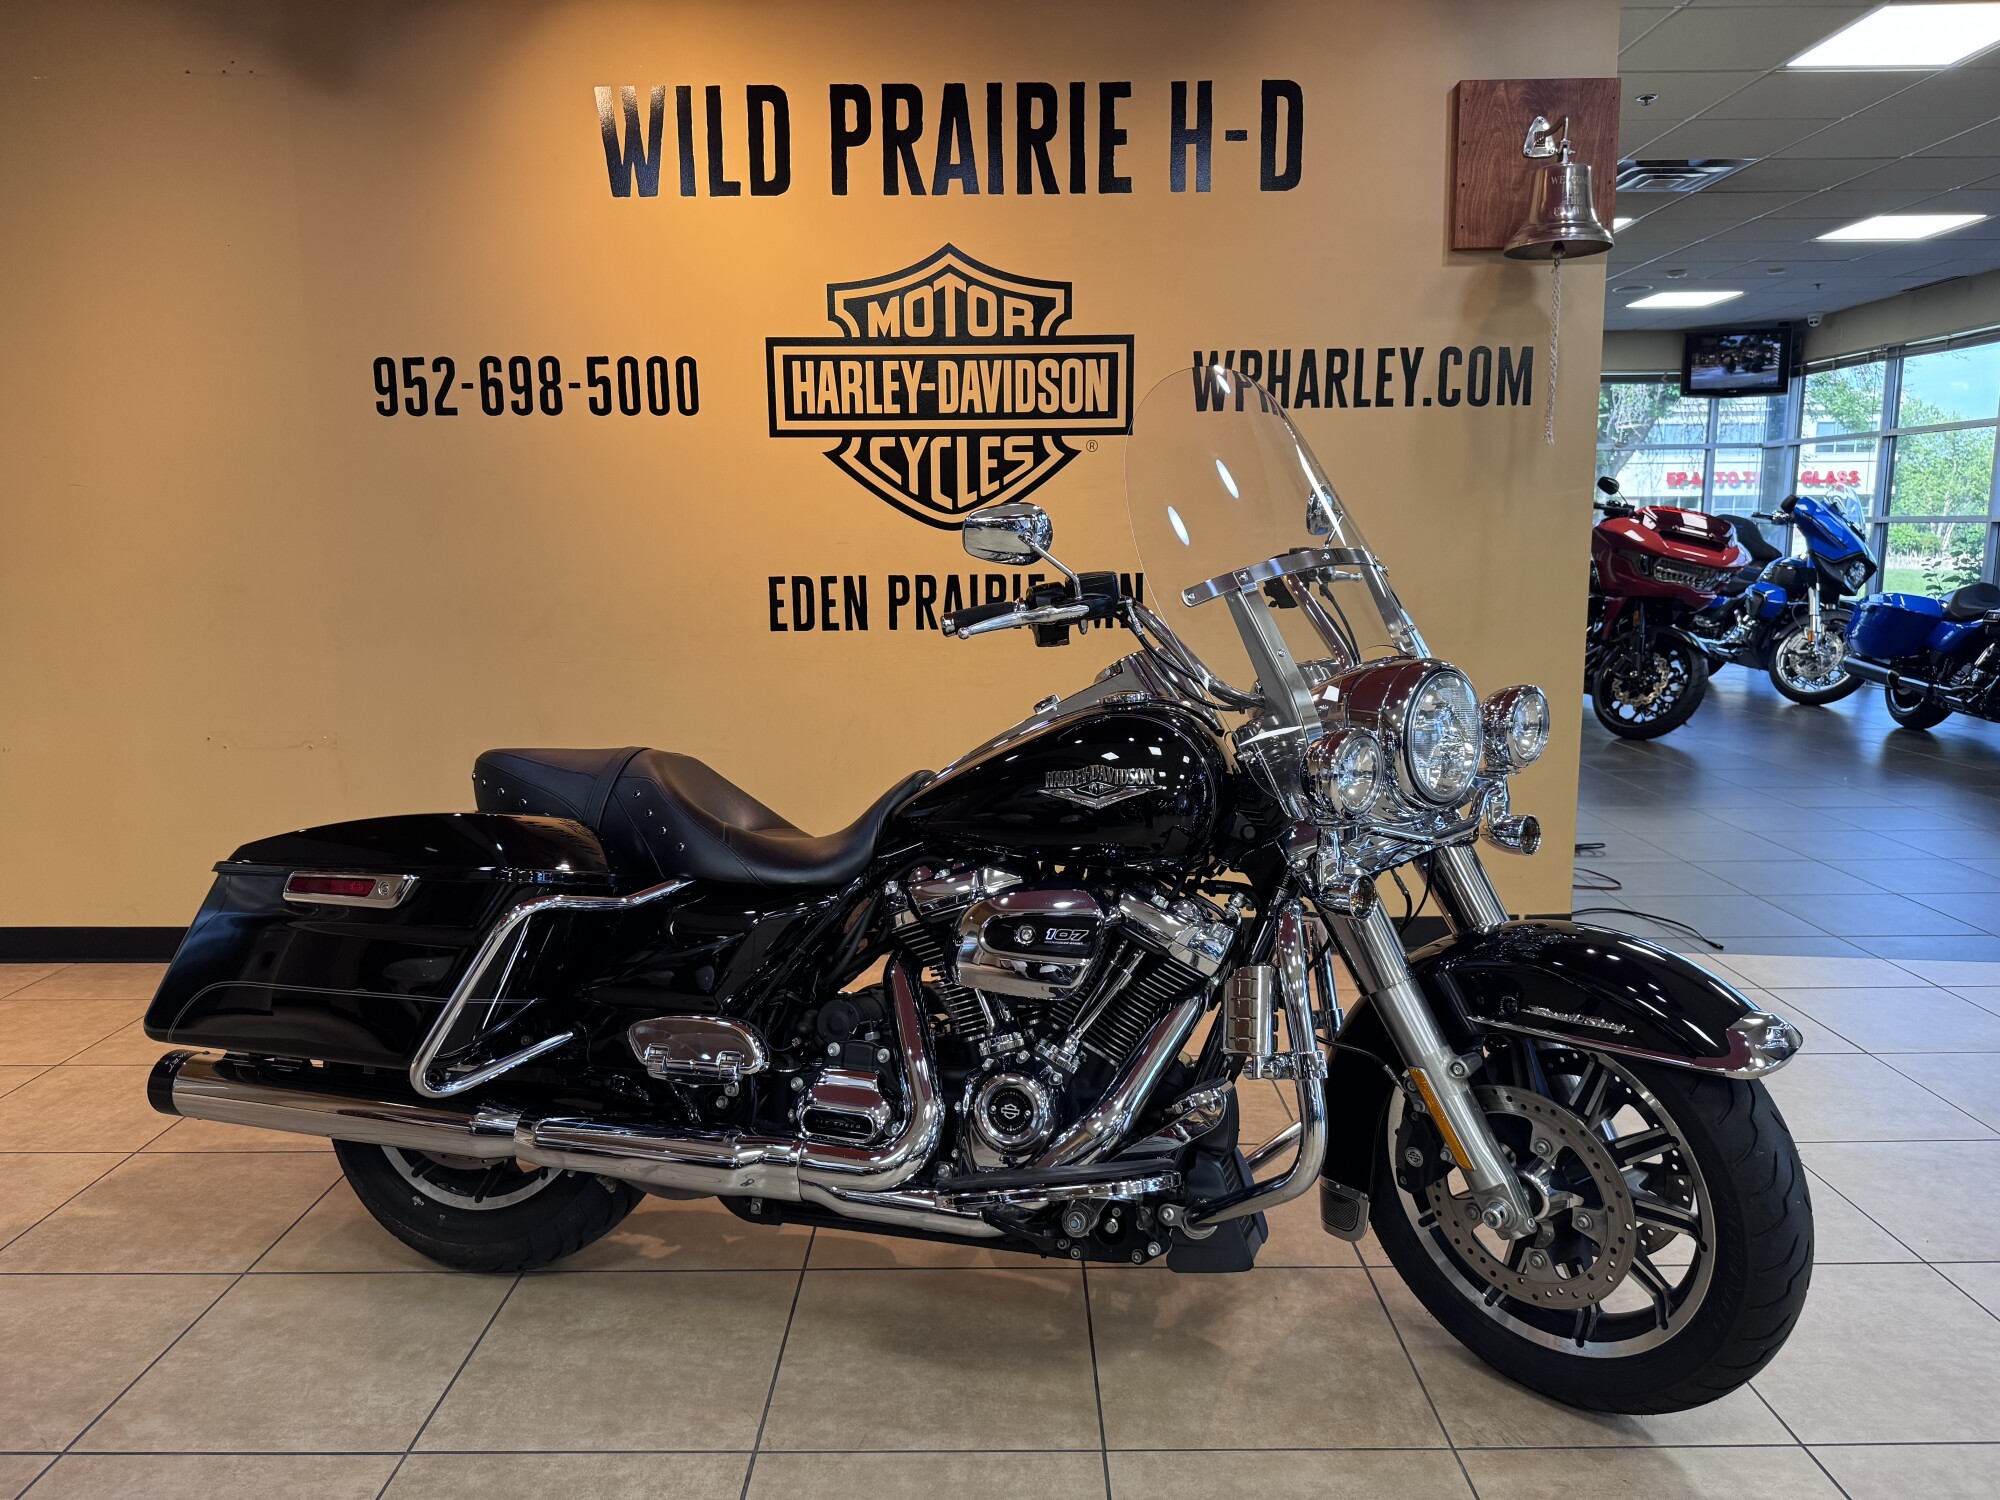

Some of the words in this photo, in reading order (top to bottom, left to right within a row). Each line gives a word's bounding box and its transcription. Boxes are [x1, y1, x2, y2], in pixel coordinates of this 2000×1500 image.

[594, 84, 792, 199] WILD
[830, 82, 1134, 197] PRAIRIE
[1170, 80, 1305, 194] H-D
[867, 272, 1034, 338] MOTOR
[373, 356, 700, 418] 952-698-5000
[791, 358, 1110, 415] HARLEY-DAVIDSON
[1193, 345, 1535, 413] WPHARLEY.COM
[869, 435, 1034, 510] CYCLES
[769, 576, 870, 633] EDEN
[888, 574, 1044, 632] PRAIRI
[1045, 928, 1089, 941] 107
